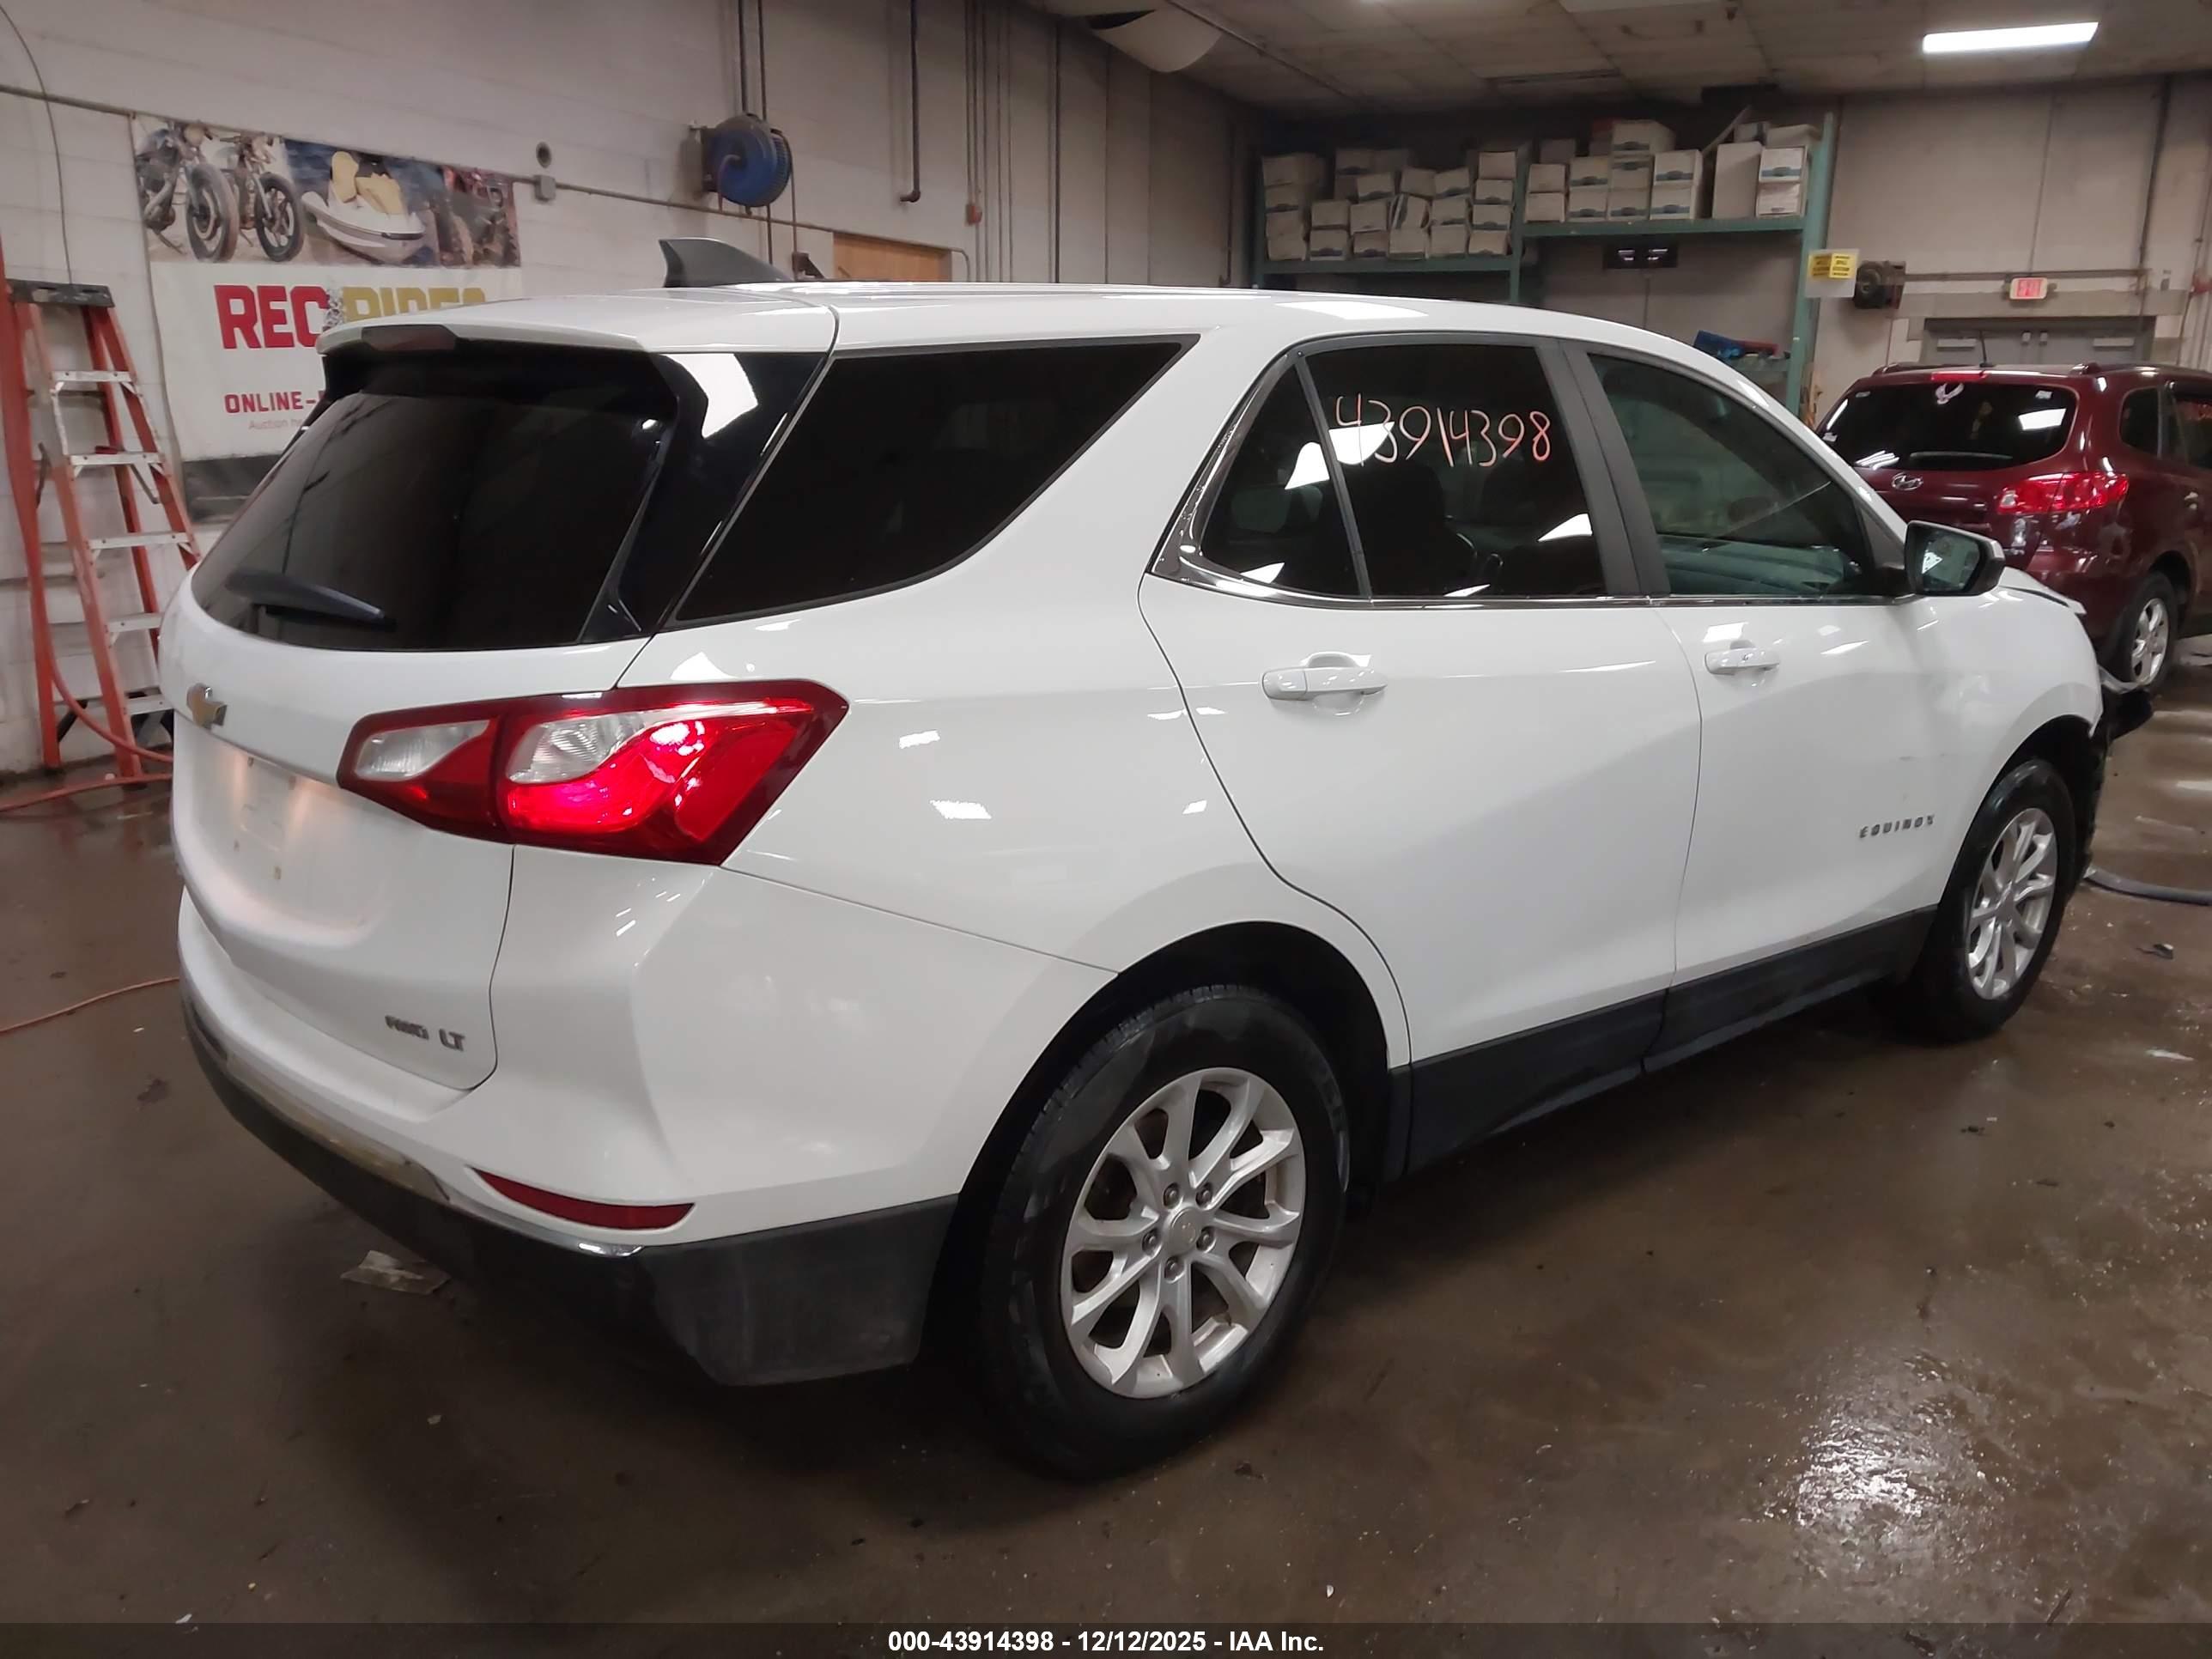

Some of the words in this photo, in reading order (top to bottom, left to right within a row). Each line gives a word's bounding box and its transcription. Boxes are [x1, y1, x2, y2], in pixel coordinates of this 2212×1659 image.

[214, 284, 330, 349] REC
[224, 391, 325, 414] ONLINE-
[1335, 392, 1551, 467] 43914398
[1859, 814, 1936, 839] EQUINOX
[439, 1028, 465, 1052] LT
